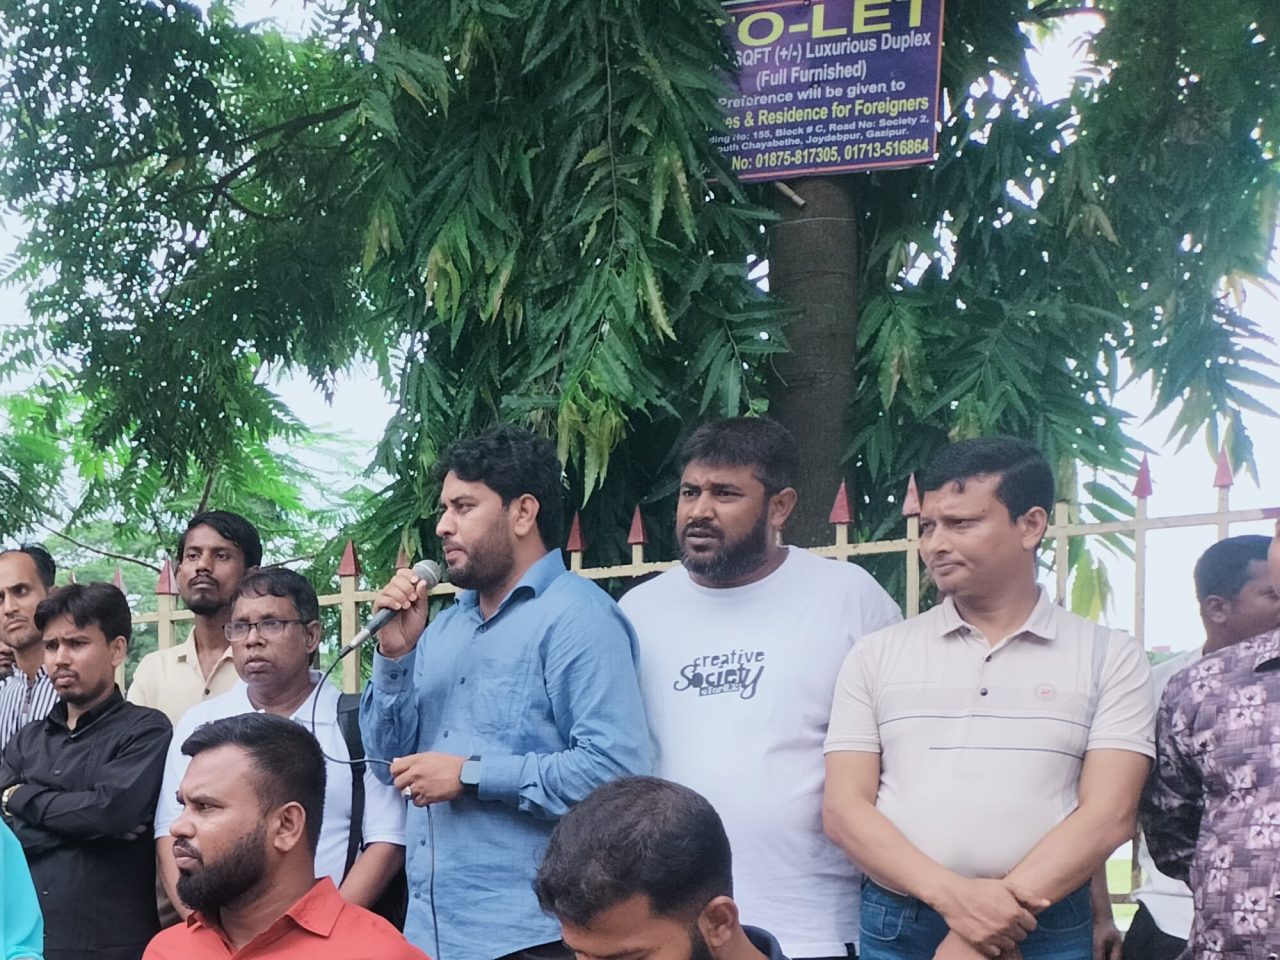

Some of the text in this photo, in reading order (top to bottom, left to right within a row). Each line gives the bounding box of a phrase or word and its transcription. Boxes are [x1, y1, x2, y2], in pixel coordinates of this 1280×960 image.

[806, 37, 877, 59] Luxurious
[881, 30, 932, 53] Duplex
[756, 59, 867, 91] (Full Furnished)
[797, 84, 821, 101] will
[826, 86, 843, 98] be
[847, 83, 887, 99] given
[890, 80, 906, 92] to
[744, 111, 754, 127] &
[758, 106, 828, 126] Residence
[832, 102, 852, 118] for
[855, 97, 929, 117] Foreigners
[775, 126, 804, 138] Block
[829, 122, 856, 132] Road
[858, 120, 876, 130] No:
[879, 116, 918, 127] Society
[806, 133, 864, 146] Joydebpur,
[866, 128, 910, 139] Gazipur.
[732, 138, 929, 170] No: 01875-817305, 01713-516864
